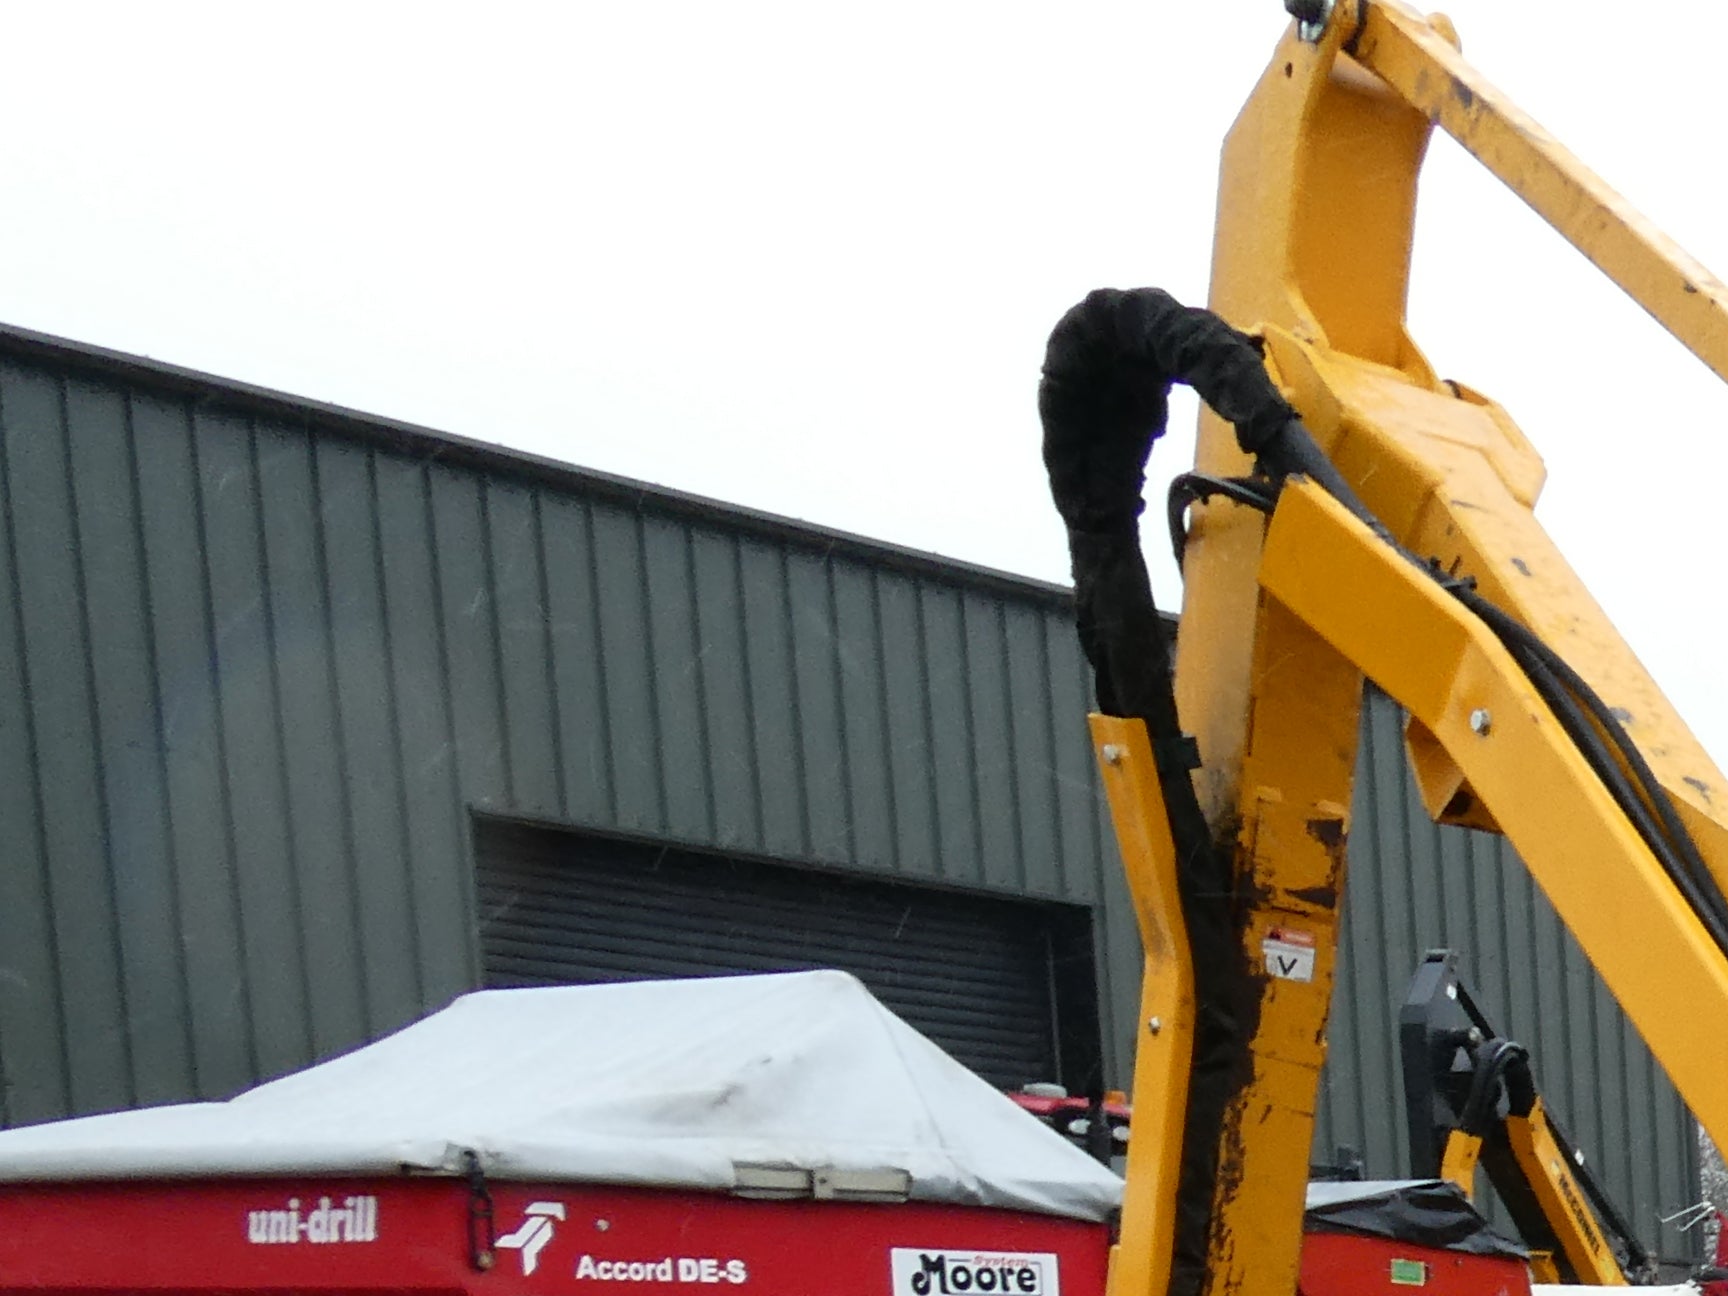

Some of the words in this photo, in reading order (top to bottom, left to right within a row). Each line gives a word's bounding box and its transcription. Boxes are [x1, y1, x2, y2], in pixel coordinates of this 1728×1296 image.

[248, 1195, 378, 1244] uni-drill
[575, 1253, 674, 1282] Accord
[677, 1258, 747, 1284] DE-S
[911, 1253, 1037, 1296] Moore
